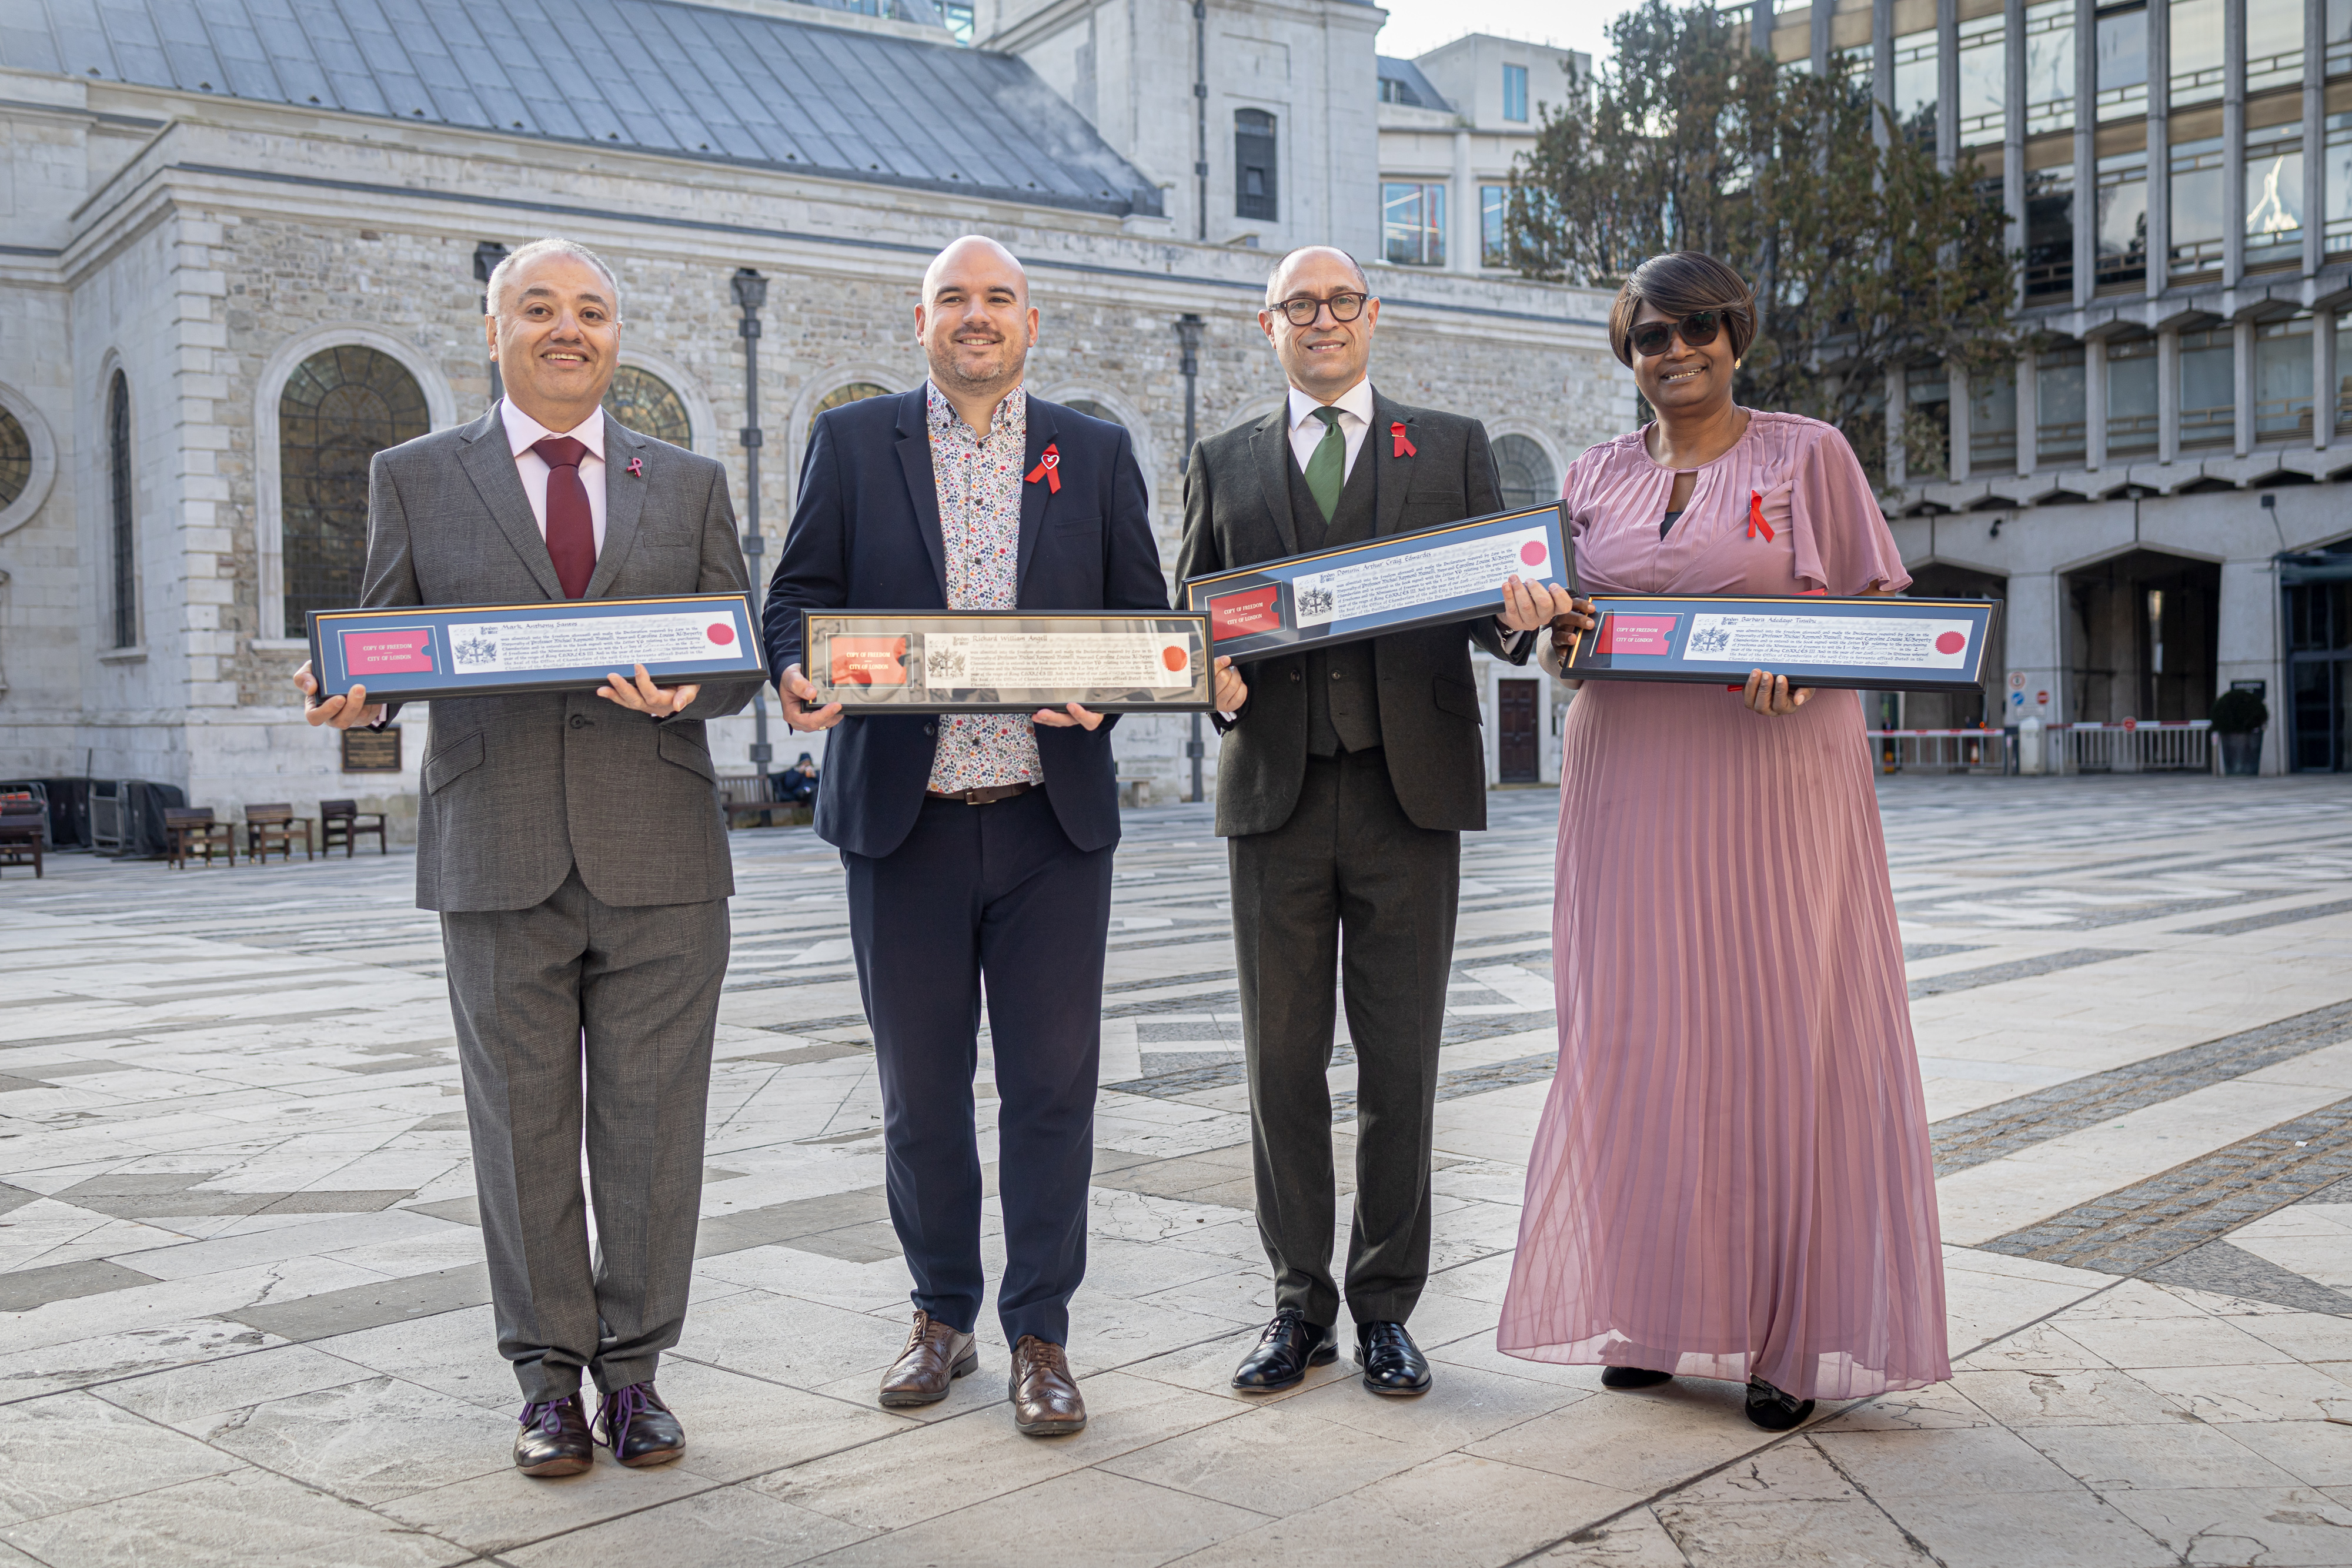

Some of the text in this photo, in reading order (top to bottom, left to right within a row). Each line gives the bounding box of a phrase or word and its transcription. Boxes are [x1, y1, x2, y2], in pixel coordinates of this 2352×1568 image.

[1337, 567, 1359, 576] Dominic
[1364, 562, 1384, 570] Arthur
[1405, 552, 1431, 561] Edwardes
[1242, 602, 1263, 611] FREEDOM
[1245, 613, 1262, 621] LONDON
